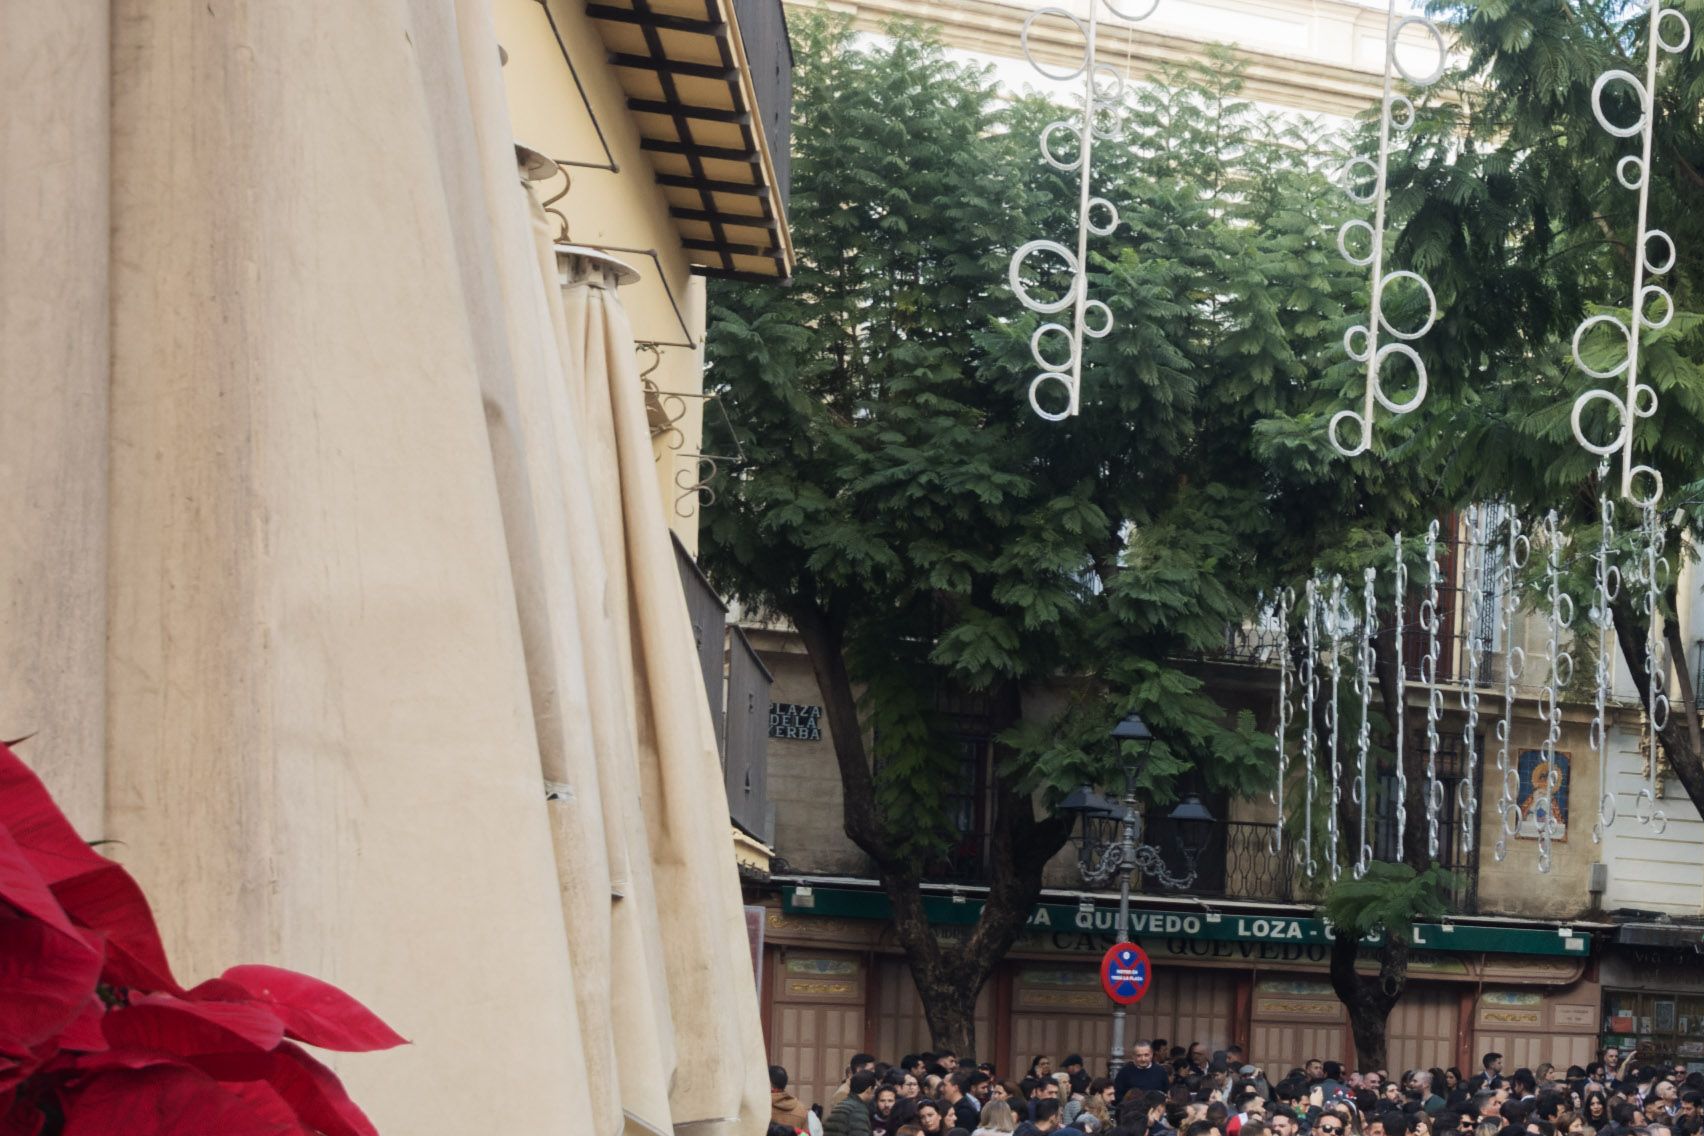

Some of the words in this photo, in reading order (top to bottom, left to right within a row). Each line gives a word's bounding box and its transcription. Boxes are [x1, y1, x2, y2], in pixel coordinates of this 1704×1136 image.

[770, 714, 790, 726] DE
[795, 716, 817, 728] LA
[1238, 919, 1303, 939] LOZA
